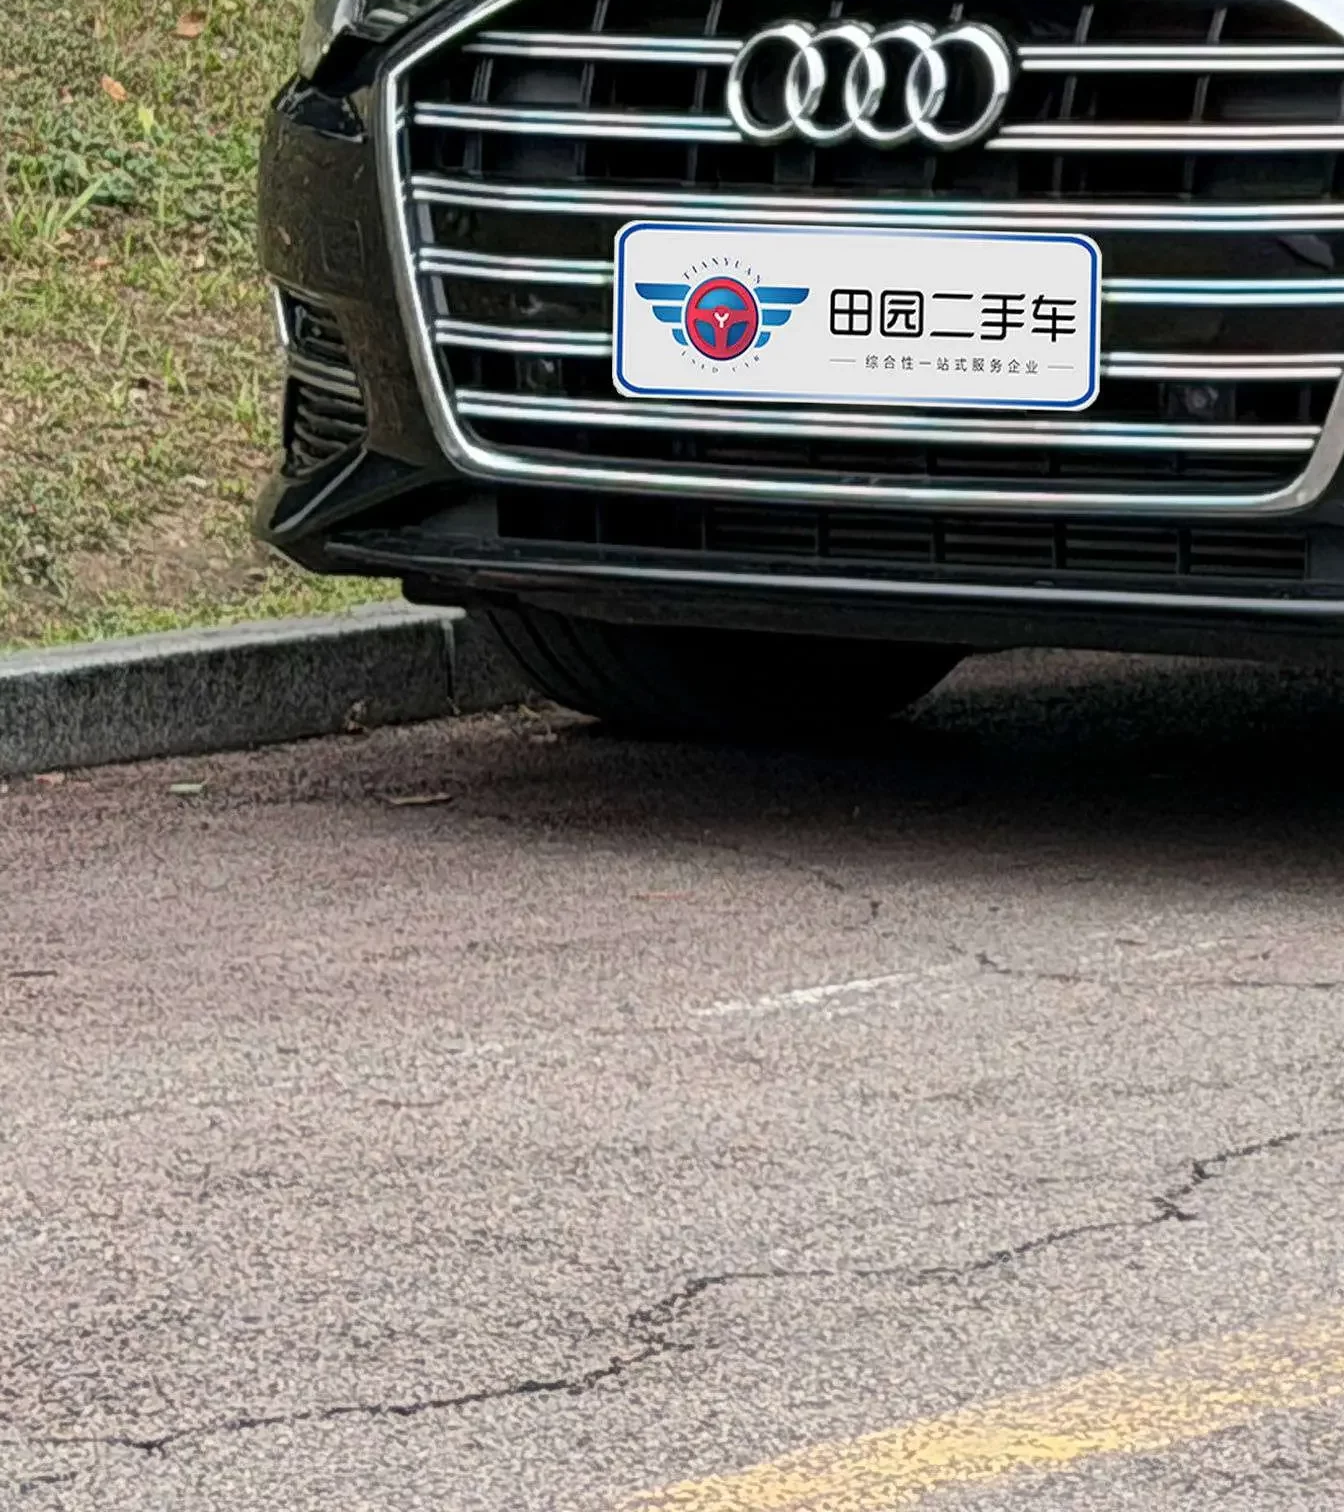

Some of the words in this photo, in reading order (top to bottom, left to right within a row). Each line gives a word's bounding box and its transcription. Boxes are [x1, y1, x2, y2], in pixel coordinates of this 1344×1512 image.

[829, 288, 1077, 343] 田园二手车
[864, 354, 1040, 375] 综合性一站式服务企业
